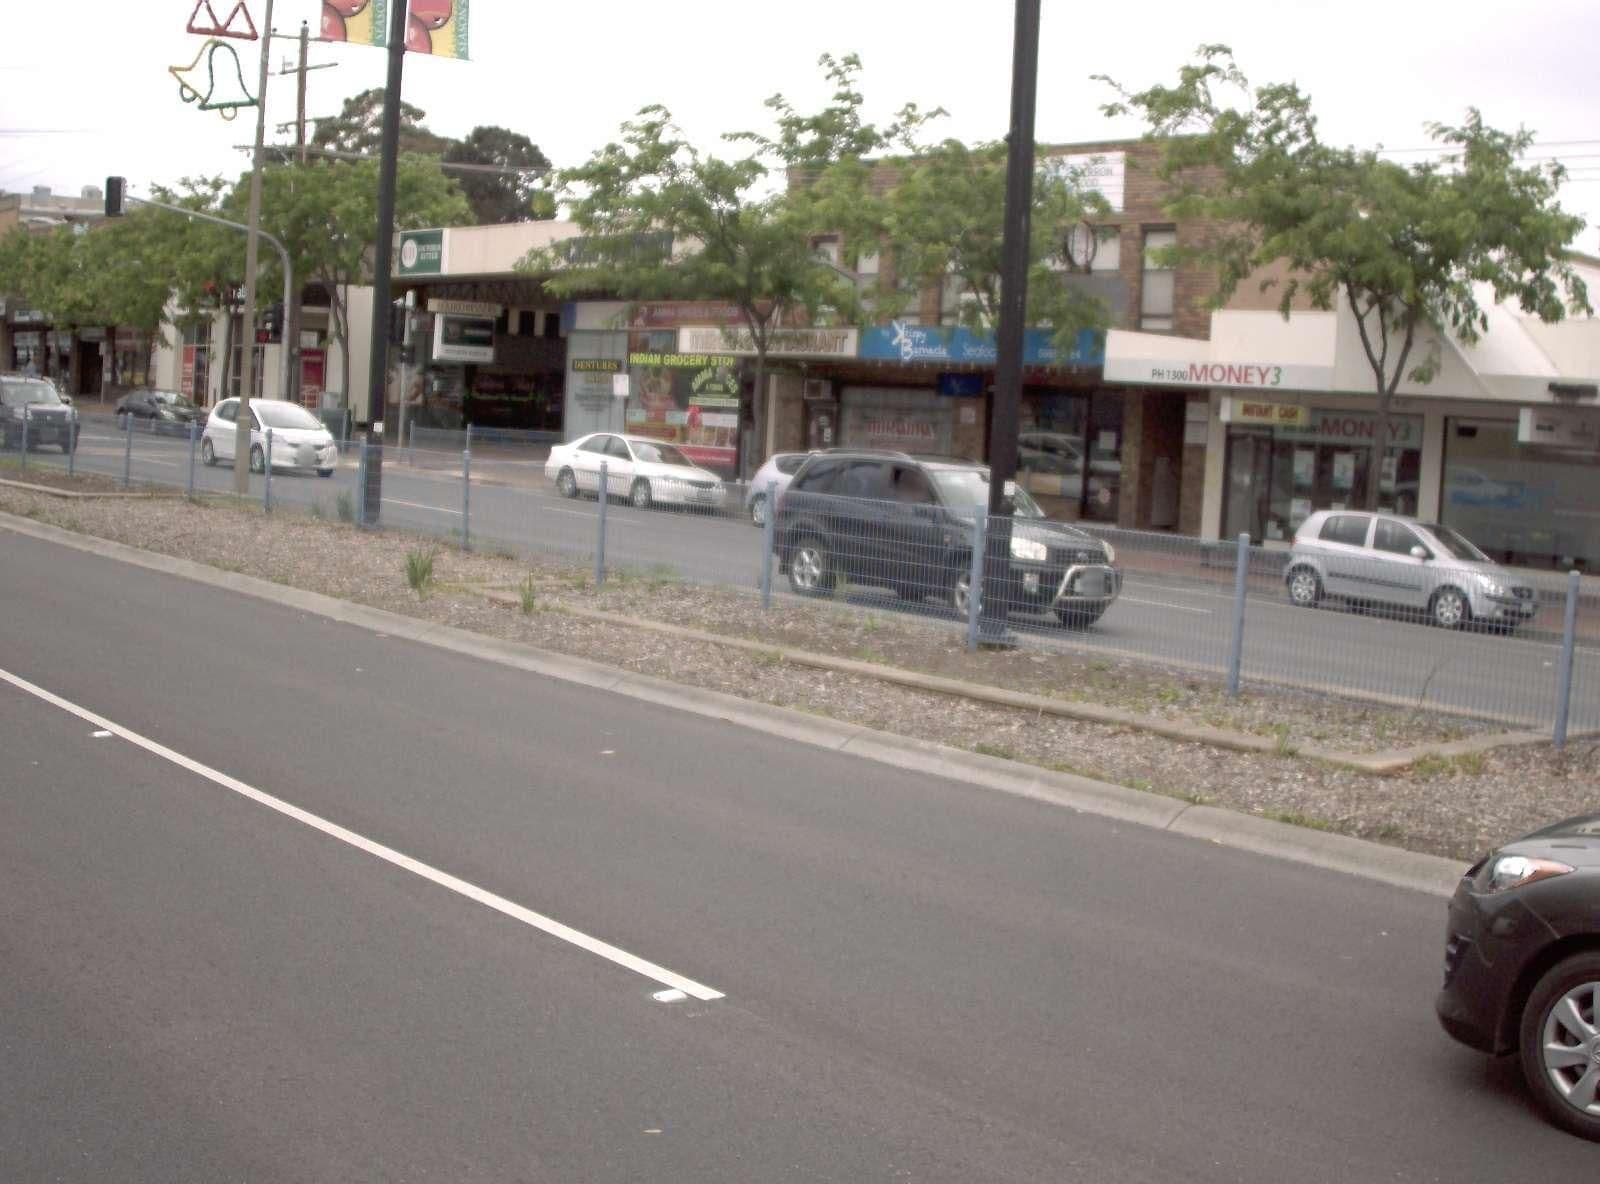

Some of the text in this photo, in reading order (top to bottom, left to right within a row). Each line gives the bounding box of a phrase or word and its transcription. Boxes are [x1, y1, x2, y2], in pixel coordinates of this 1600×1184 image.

[629, 352, 661, 366] INDIAN
[663, 353, 709, 367] GROCERY
[1319, 416, 1411, 443] MONY3
